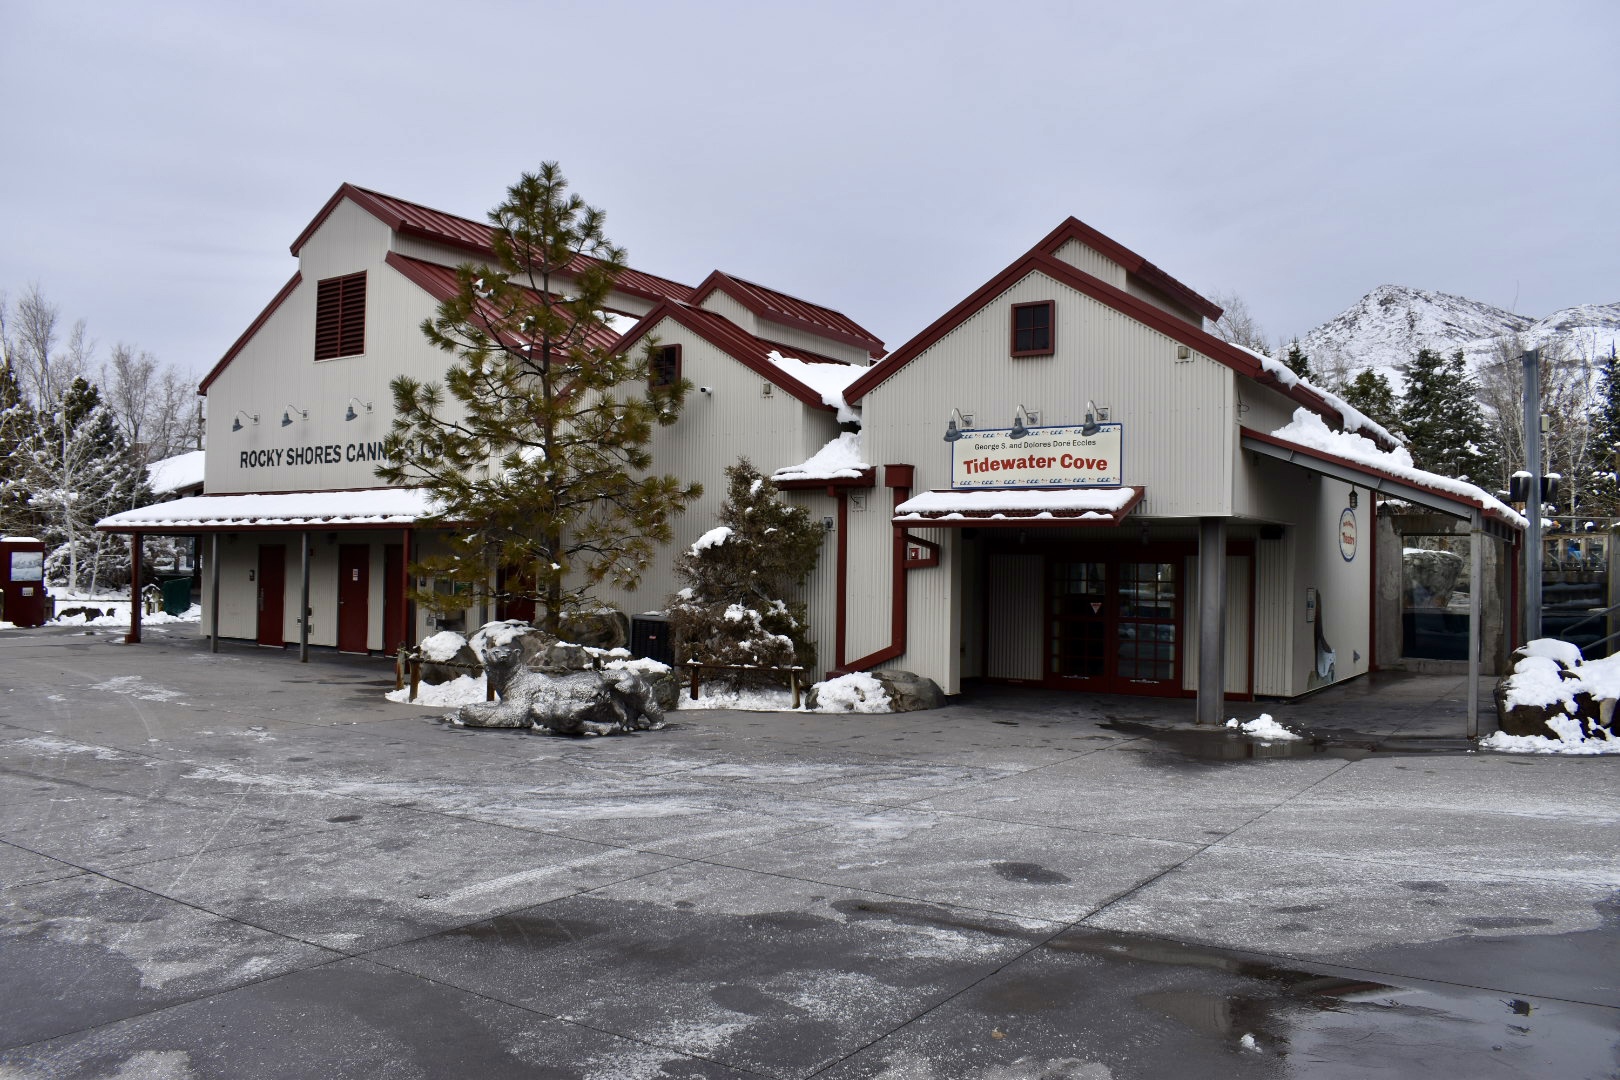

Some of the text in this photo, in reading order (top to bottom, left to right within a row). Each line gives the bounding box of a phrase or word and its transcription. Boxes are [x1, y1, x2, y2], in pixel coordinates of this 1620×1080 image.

[974, 443, 999, 451] George
[1000, 442, 1008, 450] S.
[1009, 441, 1022, 449] and
[1024, 440, 1052, 449] Dolores
[1072, 439, 1097, 447] Eccles
[240, 448, 284, 469] ROCKY
[286, 445, 342, 466] SHORES
[963, 453, 1108, 475] Tidewater Cove
